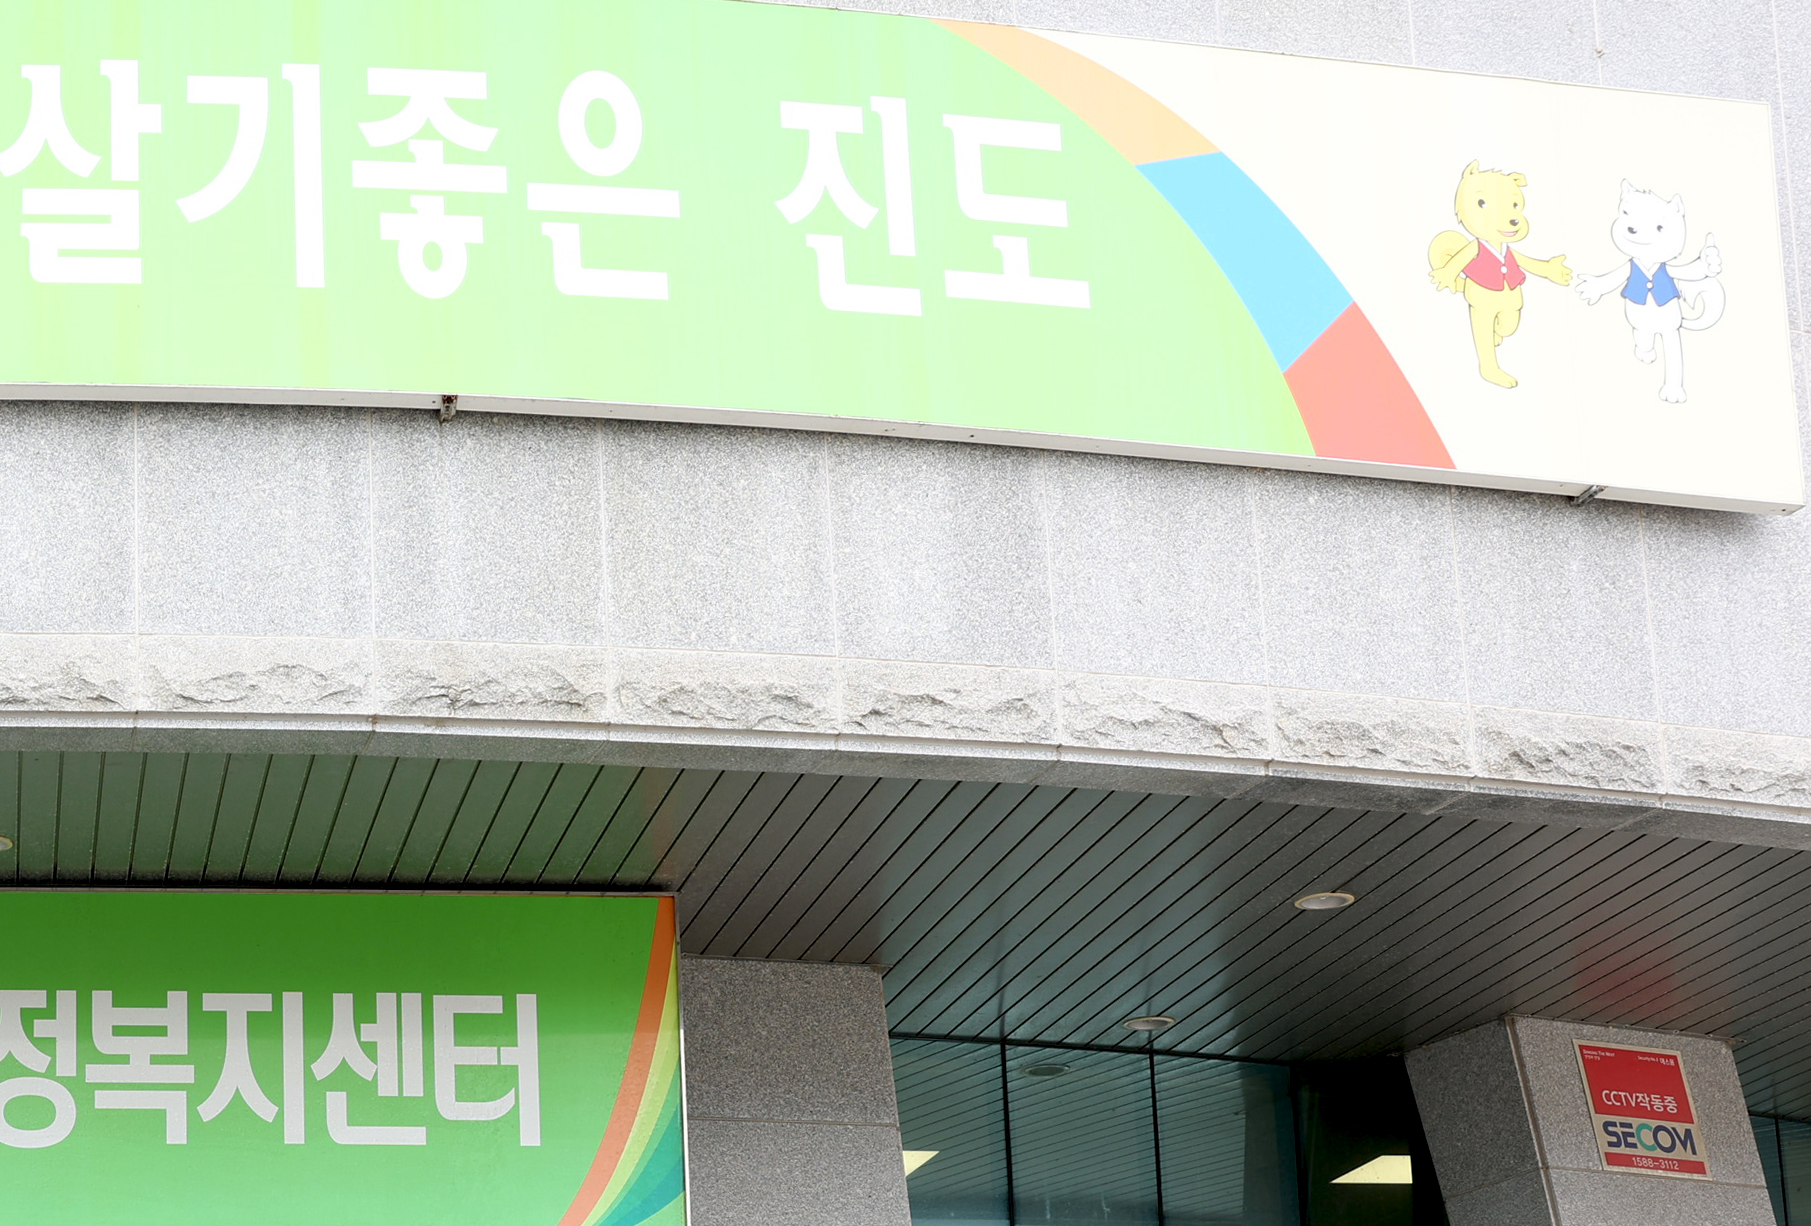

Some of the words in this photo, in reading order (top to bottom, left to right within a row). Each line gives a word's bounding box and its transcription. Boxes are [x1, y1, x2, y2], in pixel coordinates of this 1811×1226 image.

[774, 95, 1091, 317] 진도
[1602, 1089, 1678, 1115] CCTV작동중
[1603, 1120, 1698, 1156] SECOM
[1631, 1156, 1680, 1171] 1588-3112
